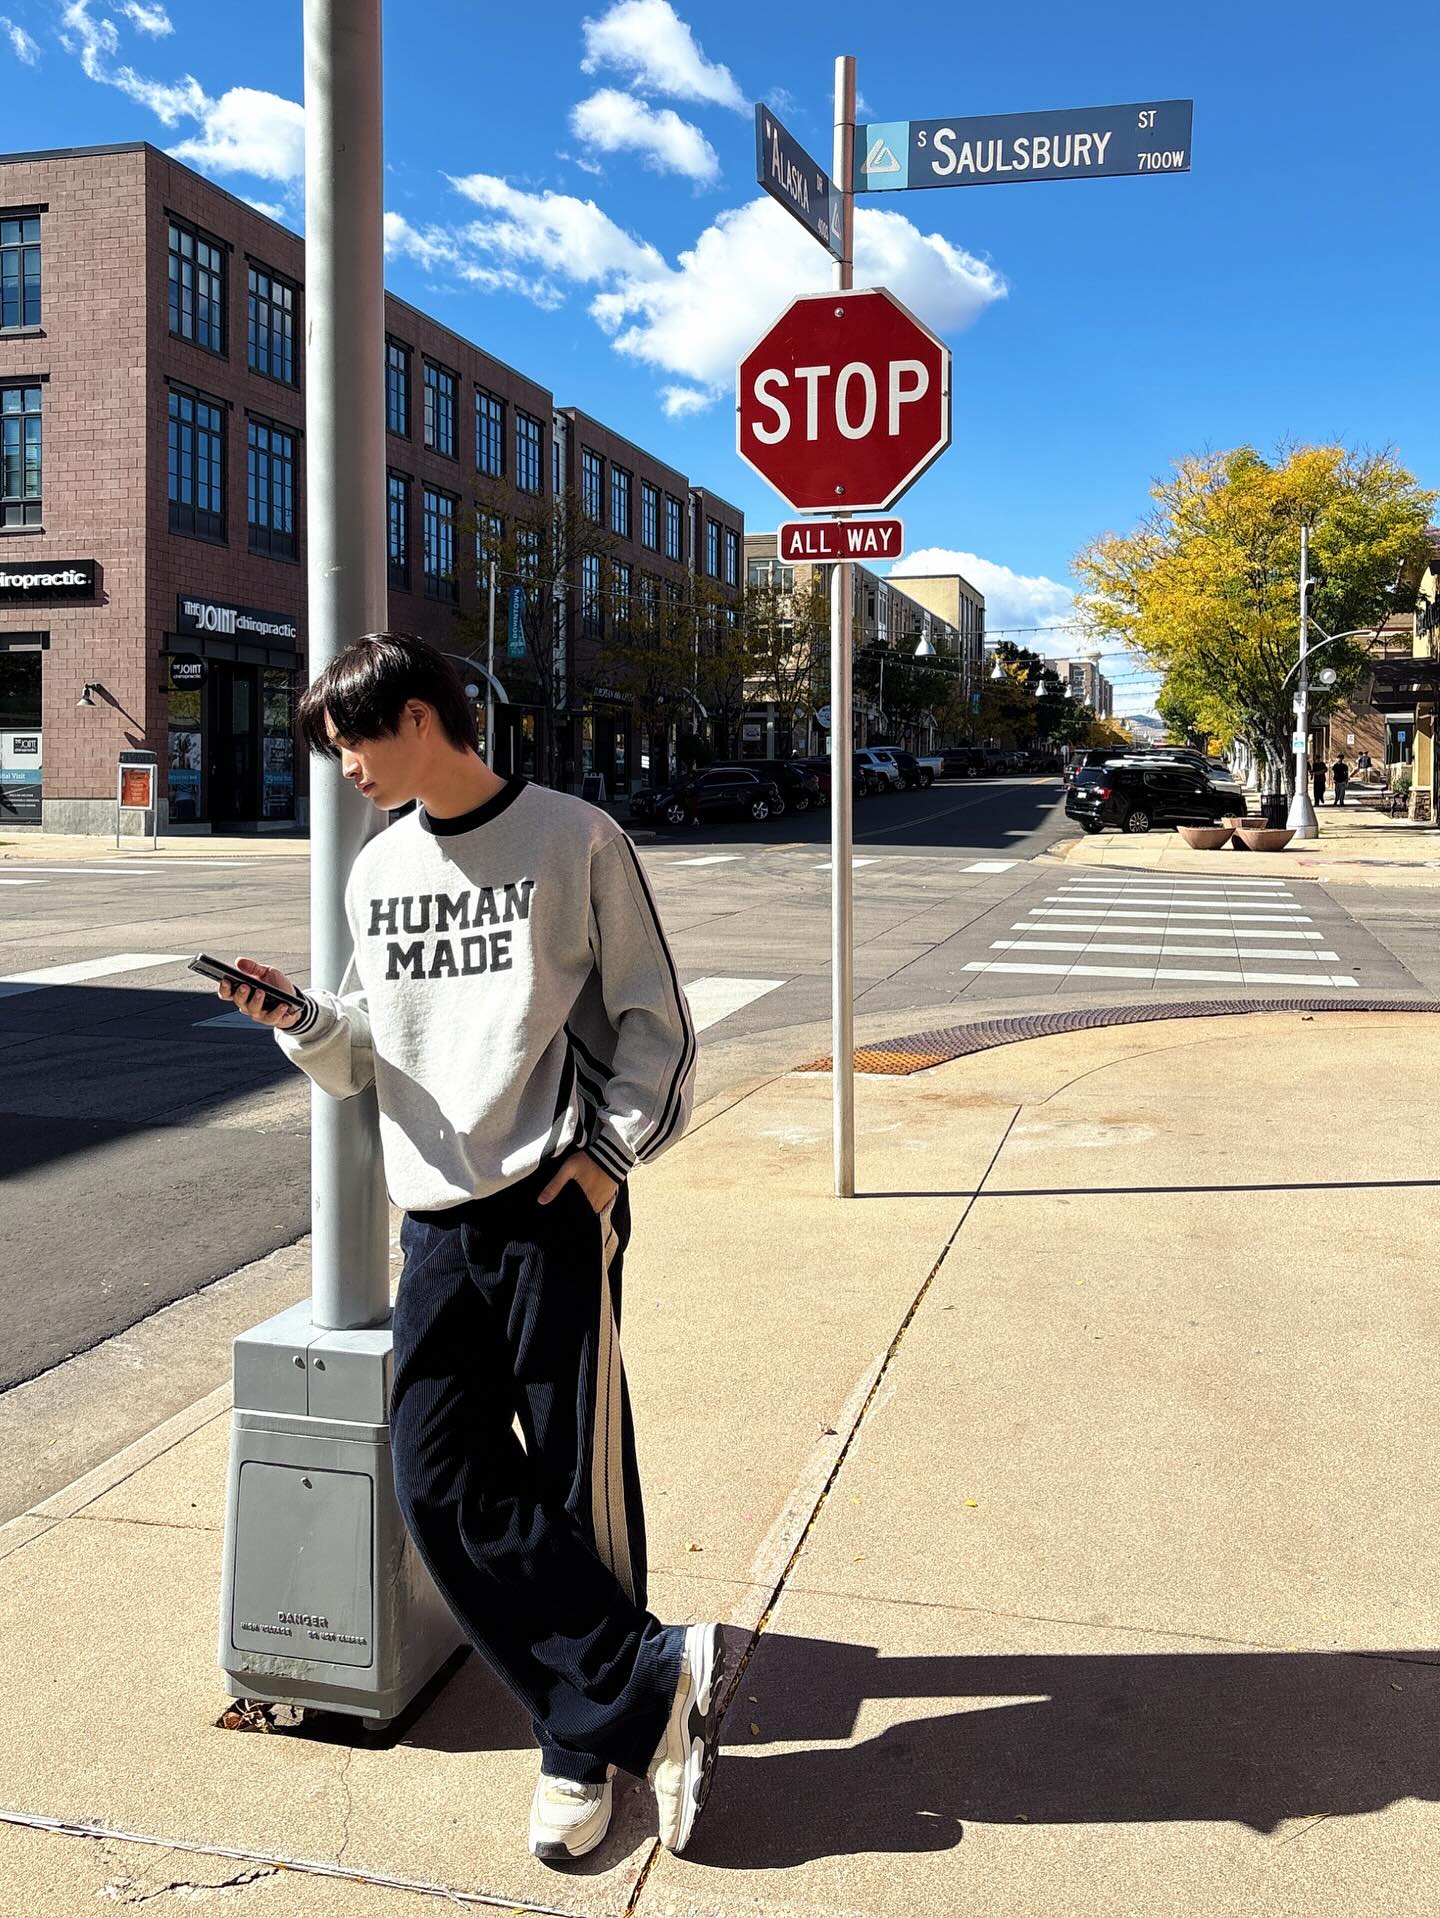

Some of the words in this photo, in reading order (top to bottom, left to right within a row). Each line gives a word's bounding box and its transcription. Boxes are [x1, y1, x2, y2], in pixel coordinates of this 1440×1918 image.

[917, 130, 928, 147] S
[931, 127, 1113, 176] SAULSBURY
[1138, 110, 1157, 129] ST
[1137, 150, 1186, 171] 7100W
[771, 127, 811, 214] ALASKA
[752, 359, 930, 446] STOP
[789, 529, 832, 554] ALL
[847, 527, 894, 553] WAY
[0, 569, 87, 590] iropractic
[196, 604, 238, 634] JOINT
[236, 616, 297, 638] chiropractic
[512, 588, 520, 639] DOWNTOWN
[179, 664, 202, 674] JOINT
[367, 880, 535, 937] HUMAN
[385, 930, 513, 980] MADE
[277, 1611, 329, 1629] DANGER
